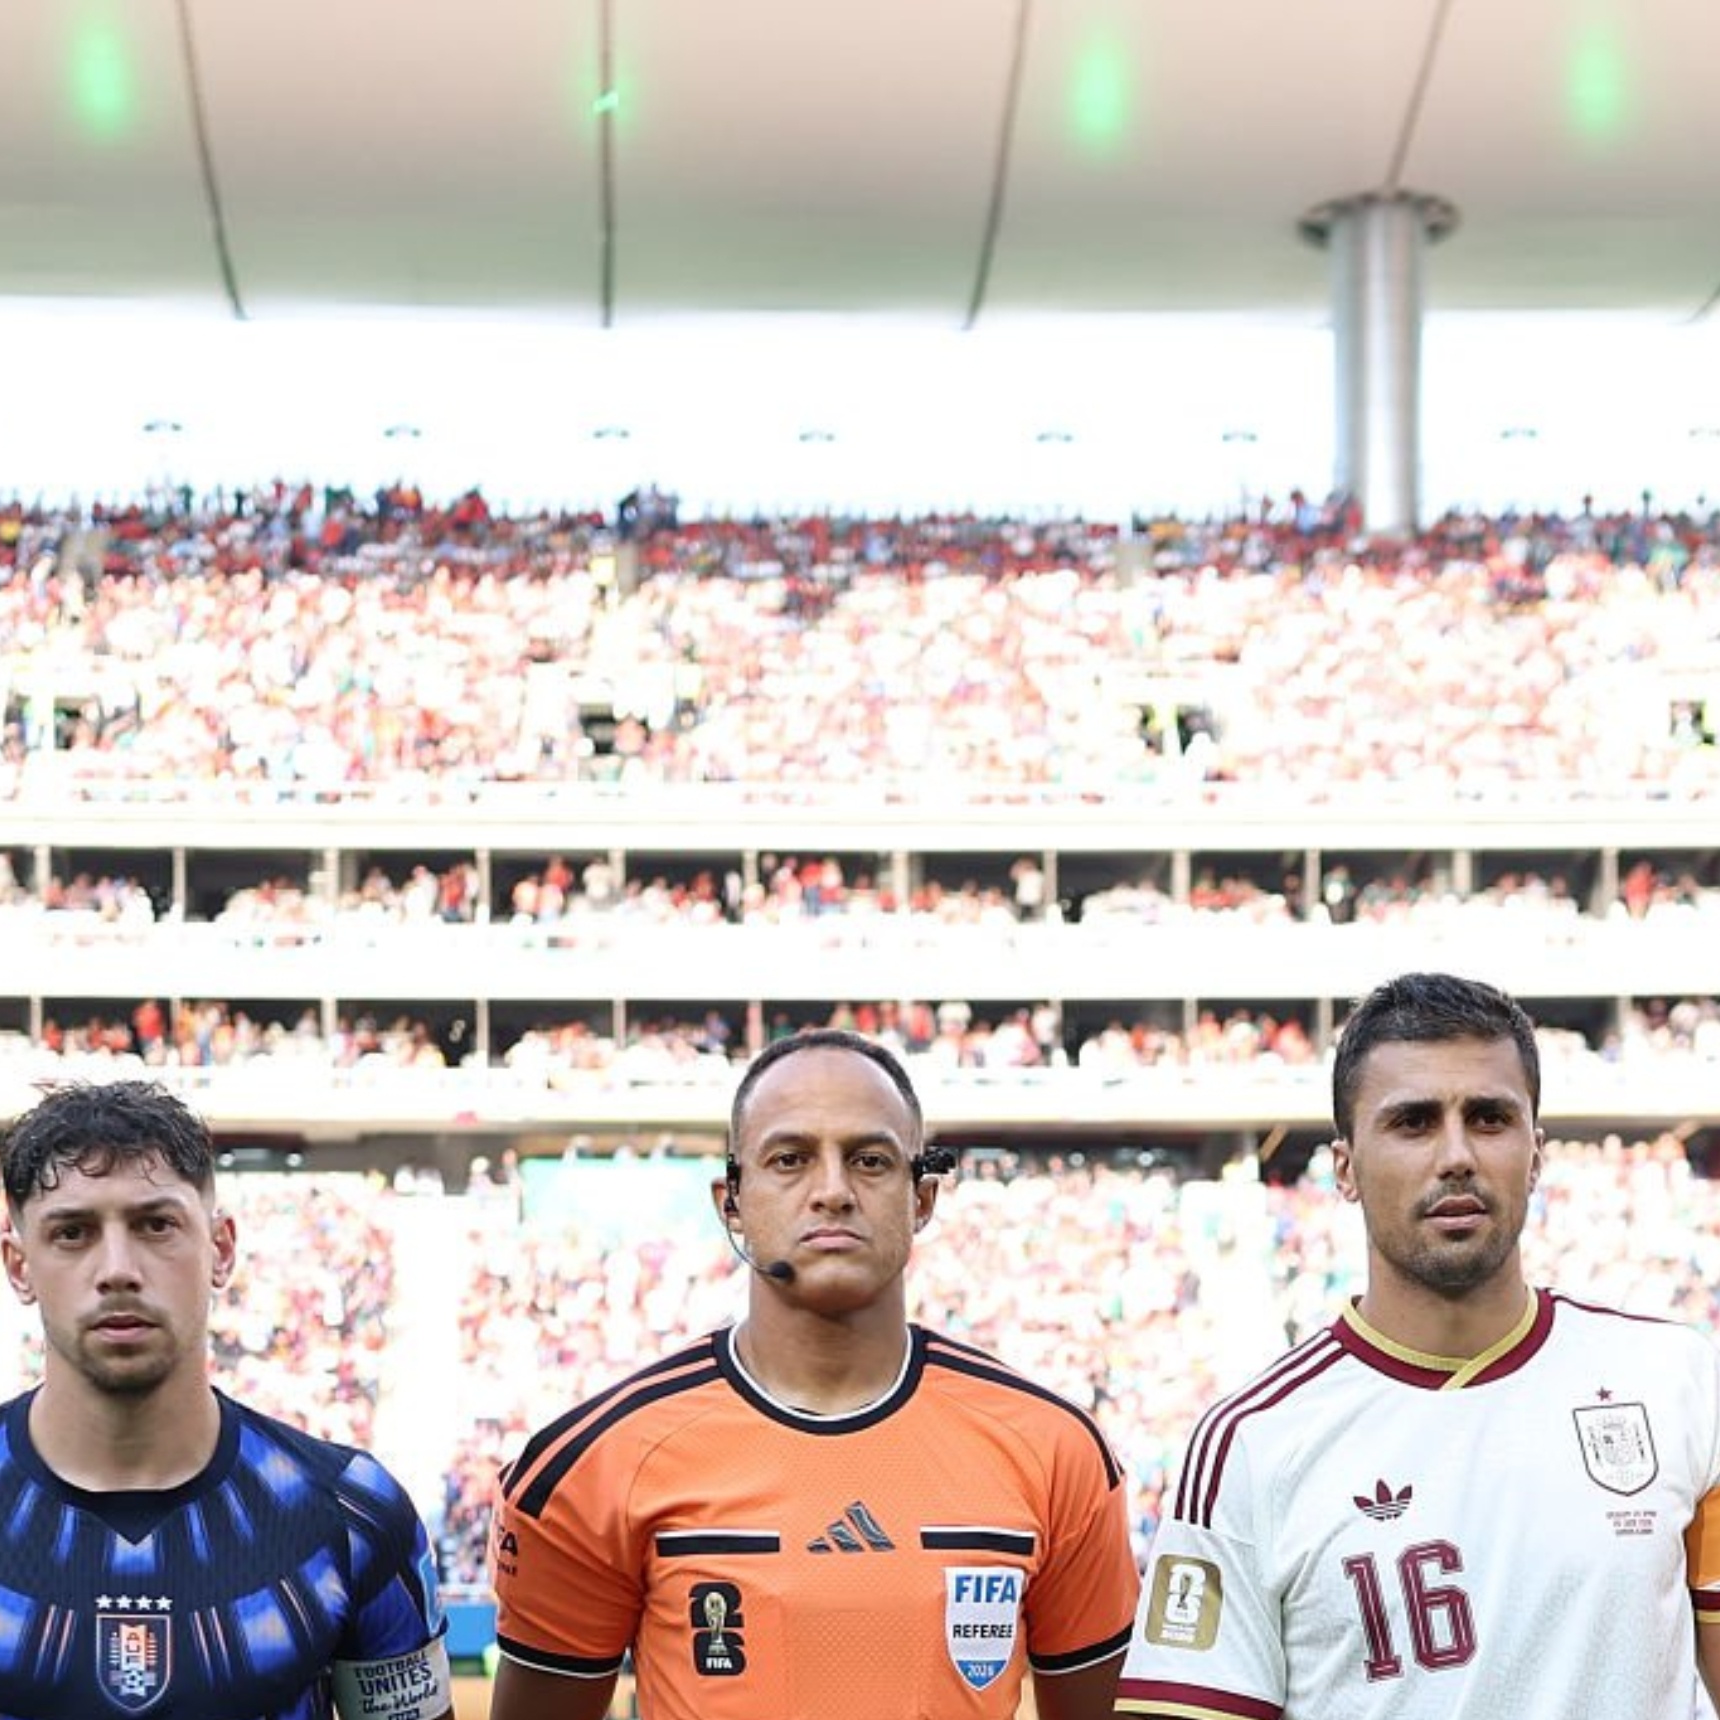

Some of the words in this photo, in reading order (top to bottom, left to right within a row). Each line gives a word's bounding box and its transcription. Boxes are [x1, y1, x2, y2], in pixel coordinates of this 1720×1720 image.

[954, 1575, 1017, 1603] FIFA
[1341, 1539, 1478, 1683] 16
[952, 1624, 1013, 1639] REFEREE
[705, 1656, 733, 1670] FIFA
[358, 1660, 432, 1697] UNITES
